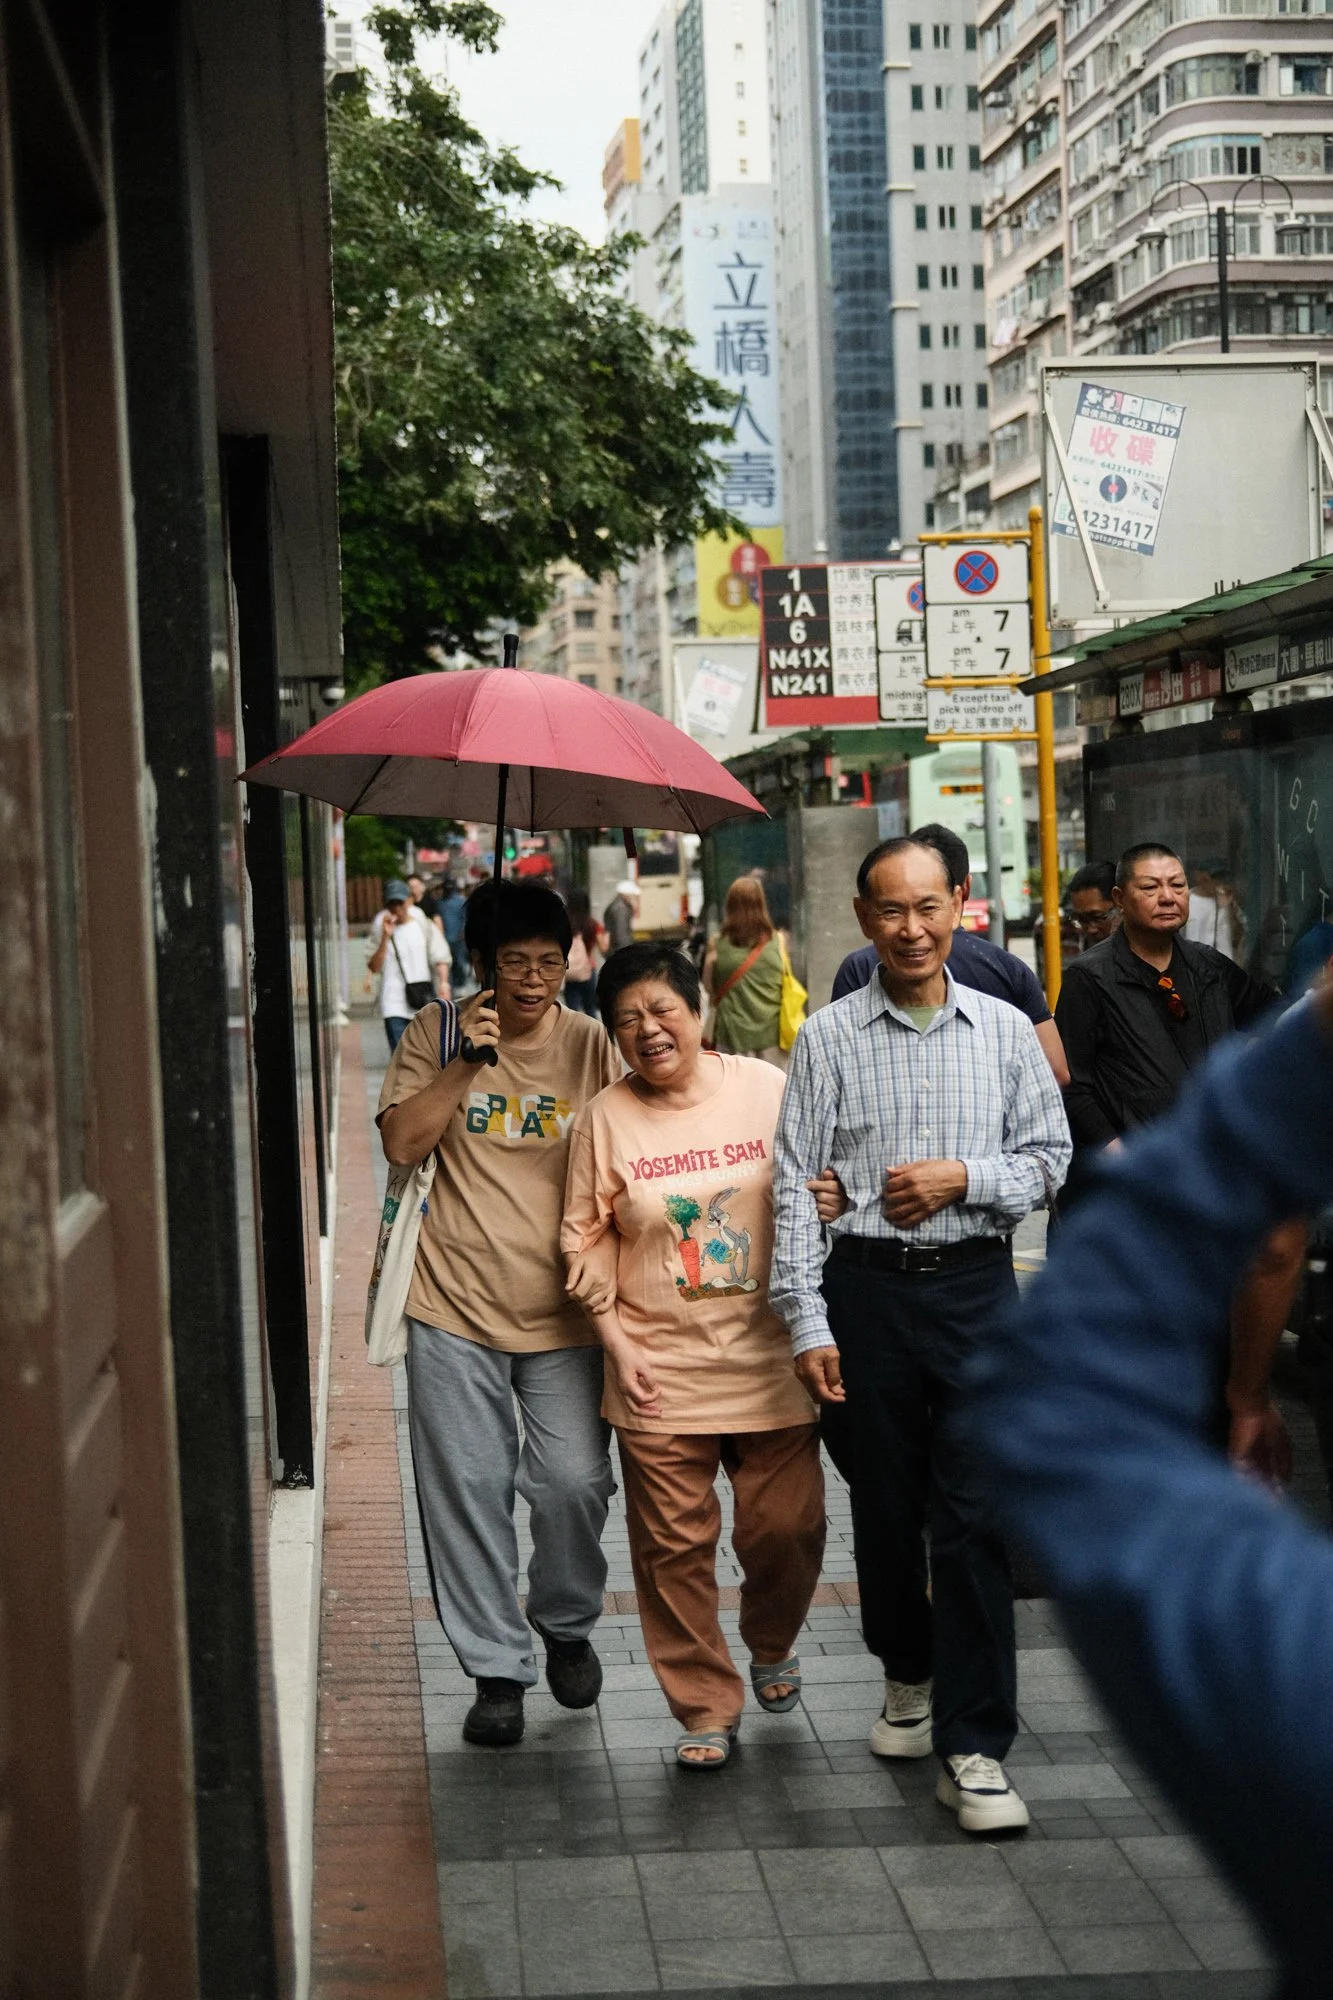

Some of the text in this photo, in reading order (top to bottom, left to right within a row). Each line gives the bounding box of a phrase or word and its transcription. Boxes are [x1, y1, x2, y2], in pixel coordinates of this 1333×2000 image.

[713, 251, 775, 509] 立橋人壽
[1122, 417, 1148, 430] 6423
[1151, 423, 1177, 437] 1417
[1089, 425, 1157, 466] 收碟
[788, 568, 801, 592] 1
[779, 595, 816, 618] 1A
[953, 609, 970, 617] am
[948, 621, 976, 634] 上午
[994, 610, 1009, 632] 7
[789, 621, 807, 644] 6
[769, 647, 830, 670] N41X
[901, 655, 917, 663] am
[953, 647, 972, 656] pm
[995, 648, 1010, 670] 7
[896, 666, 922, 678] 上午
[949, 659, 978, 671] 下午
[771, 674, 830, 696] N241
[898, 703, 925, 715] 午夜
[952, 693, 1010, 704] Except taxi
[939, 704, 1024, 715] pick up/drop off
[934, 717, 1028, 729] 的士上落客除外
[466, 1107, 577, 1139] GALAXY
[723, 1139, 767, 1167] SAM
